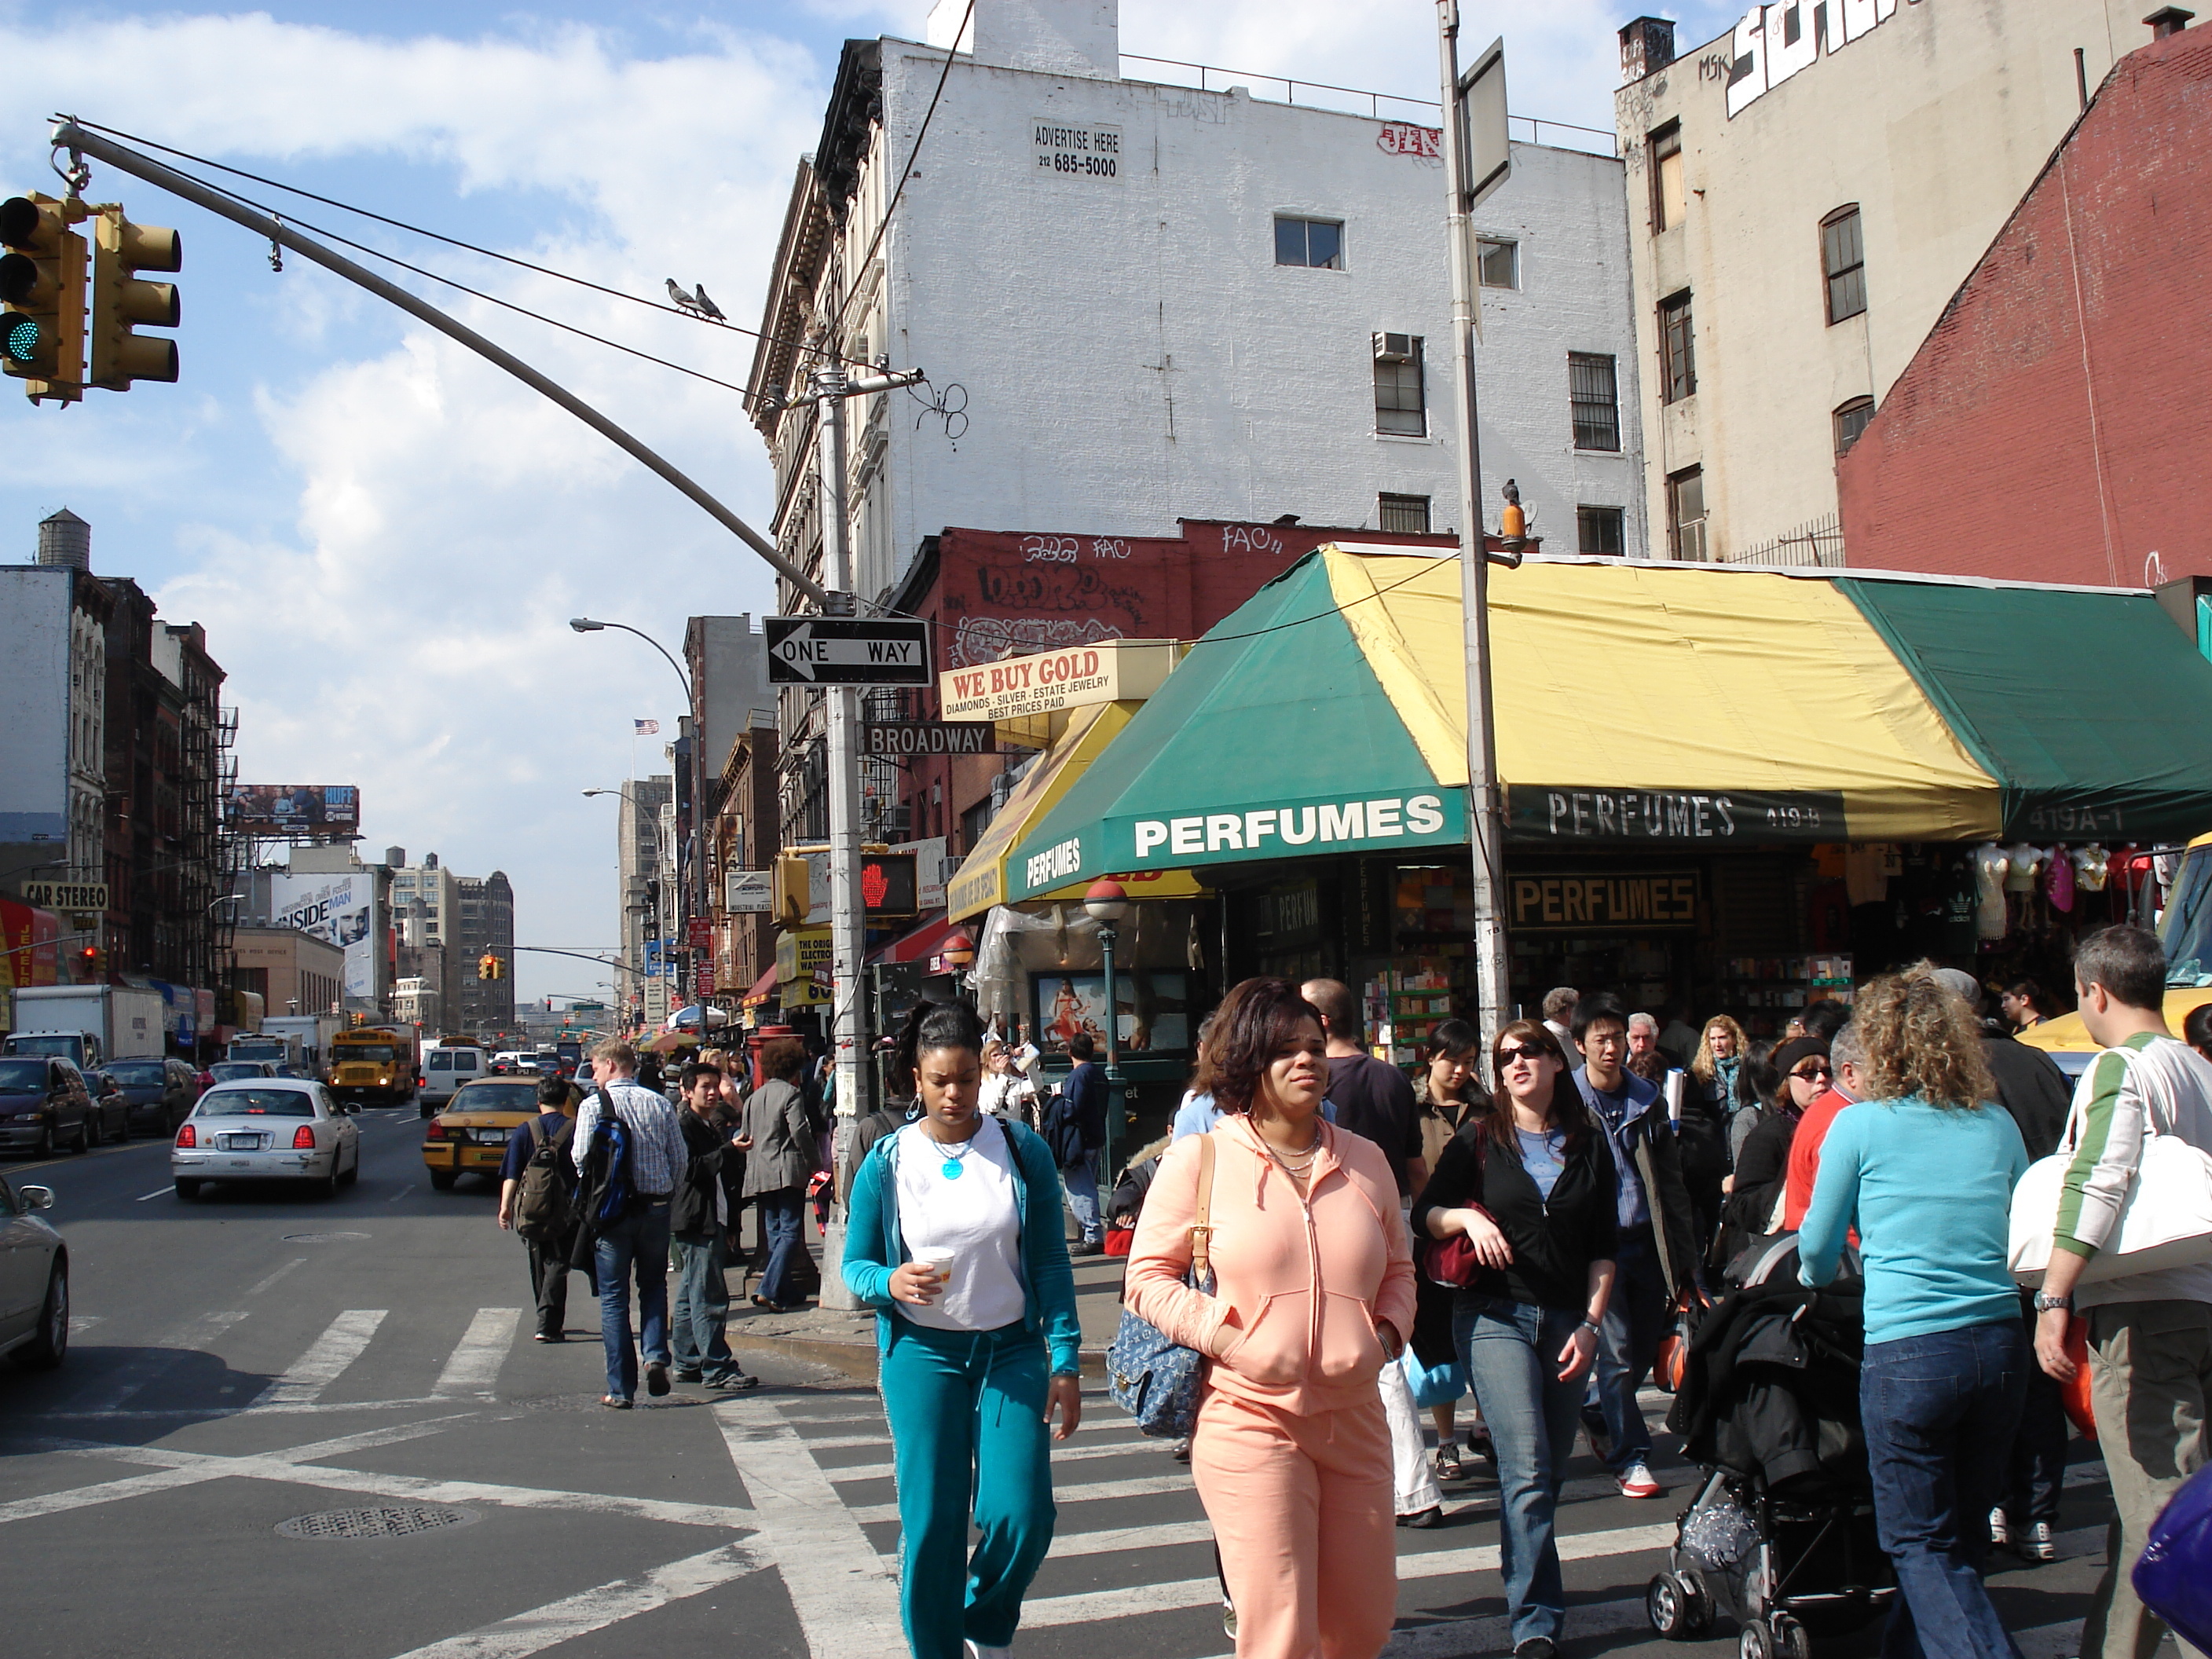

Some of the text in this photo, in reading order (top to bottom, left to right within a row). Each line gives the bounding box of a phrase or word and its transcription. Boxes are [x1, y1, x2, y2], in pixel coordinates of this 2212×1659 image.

[1699, 53, 1734, 81] MSK
[1035, 126, 1119, 153] ADVERTISE HERE
[1038, 153, 1116, 178] 212 685-5000
[782, 640, 911, 662] ONE WAY
[952, 650, 1099, 700] WE BUY GOLD
[947, 676, 1109, 715] DIAMONDS SILVER ESTATE JEWELRY
[988, 696, 1064, 719] BEST PRICES PAID
[870, 727, 987, 753] BROADWAY
[325, 786, 353, 804] HUFF
[1134, 794, 1445, 858] PERFUMES
[1547, 793, 1736, 837] PERFUMES
[1027, 837, 1081, 889] PERFUMES
[27, 884, 107, 907] CAR STEREO
[329, 891, 351, 910] MAN
[1514, 878, 1694, 922] PERFUMES
[799, 939, 811, 949] THE
